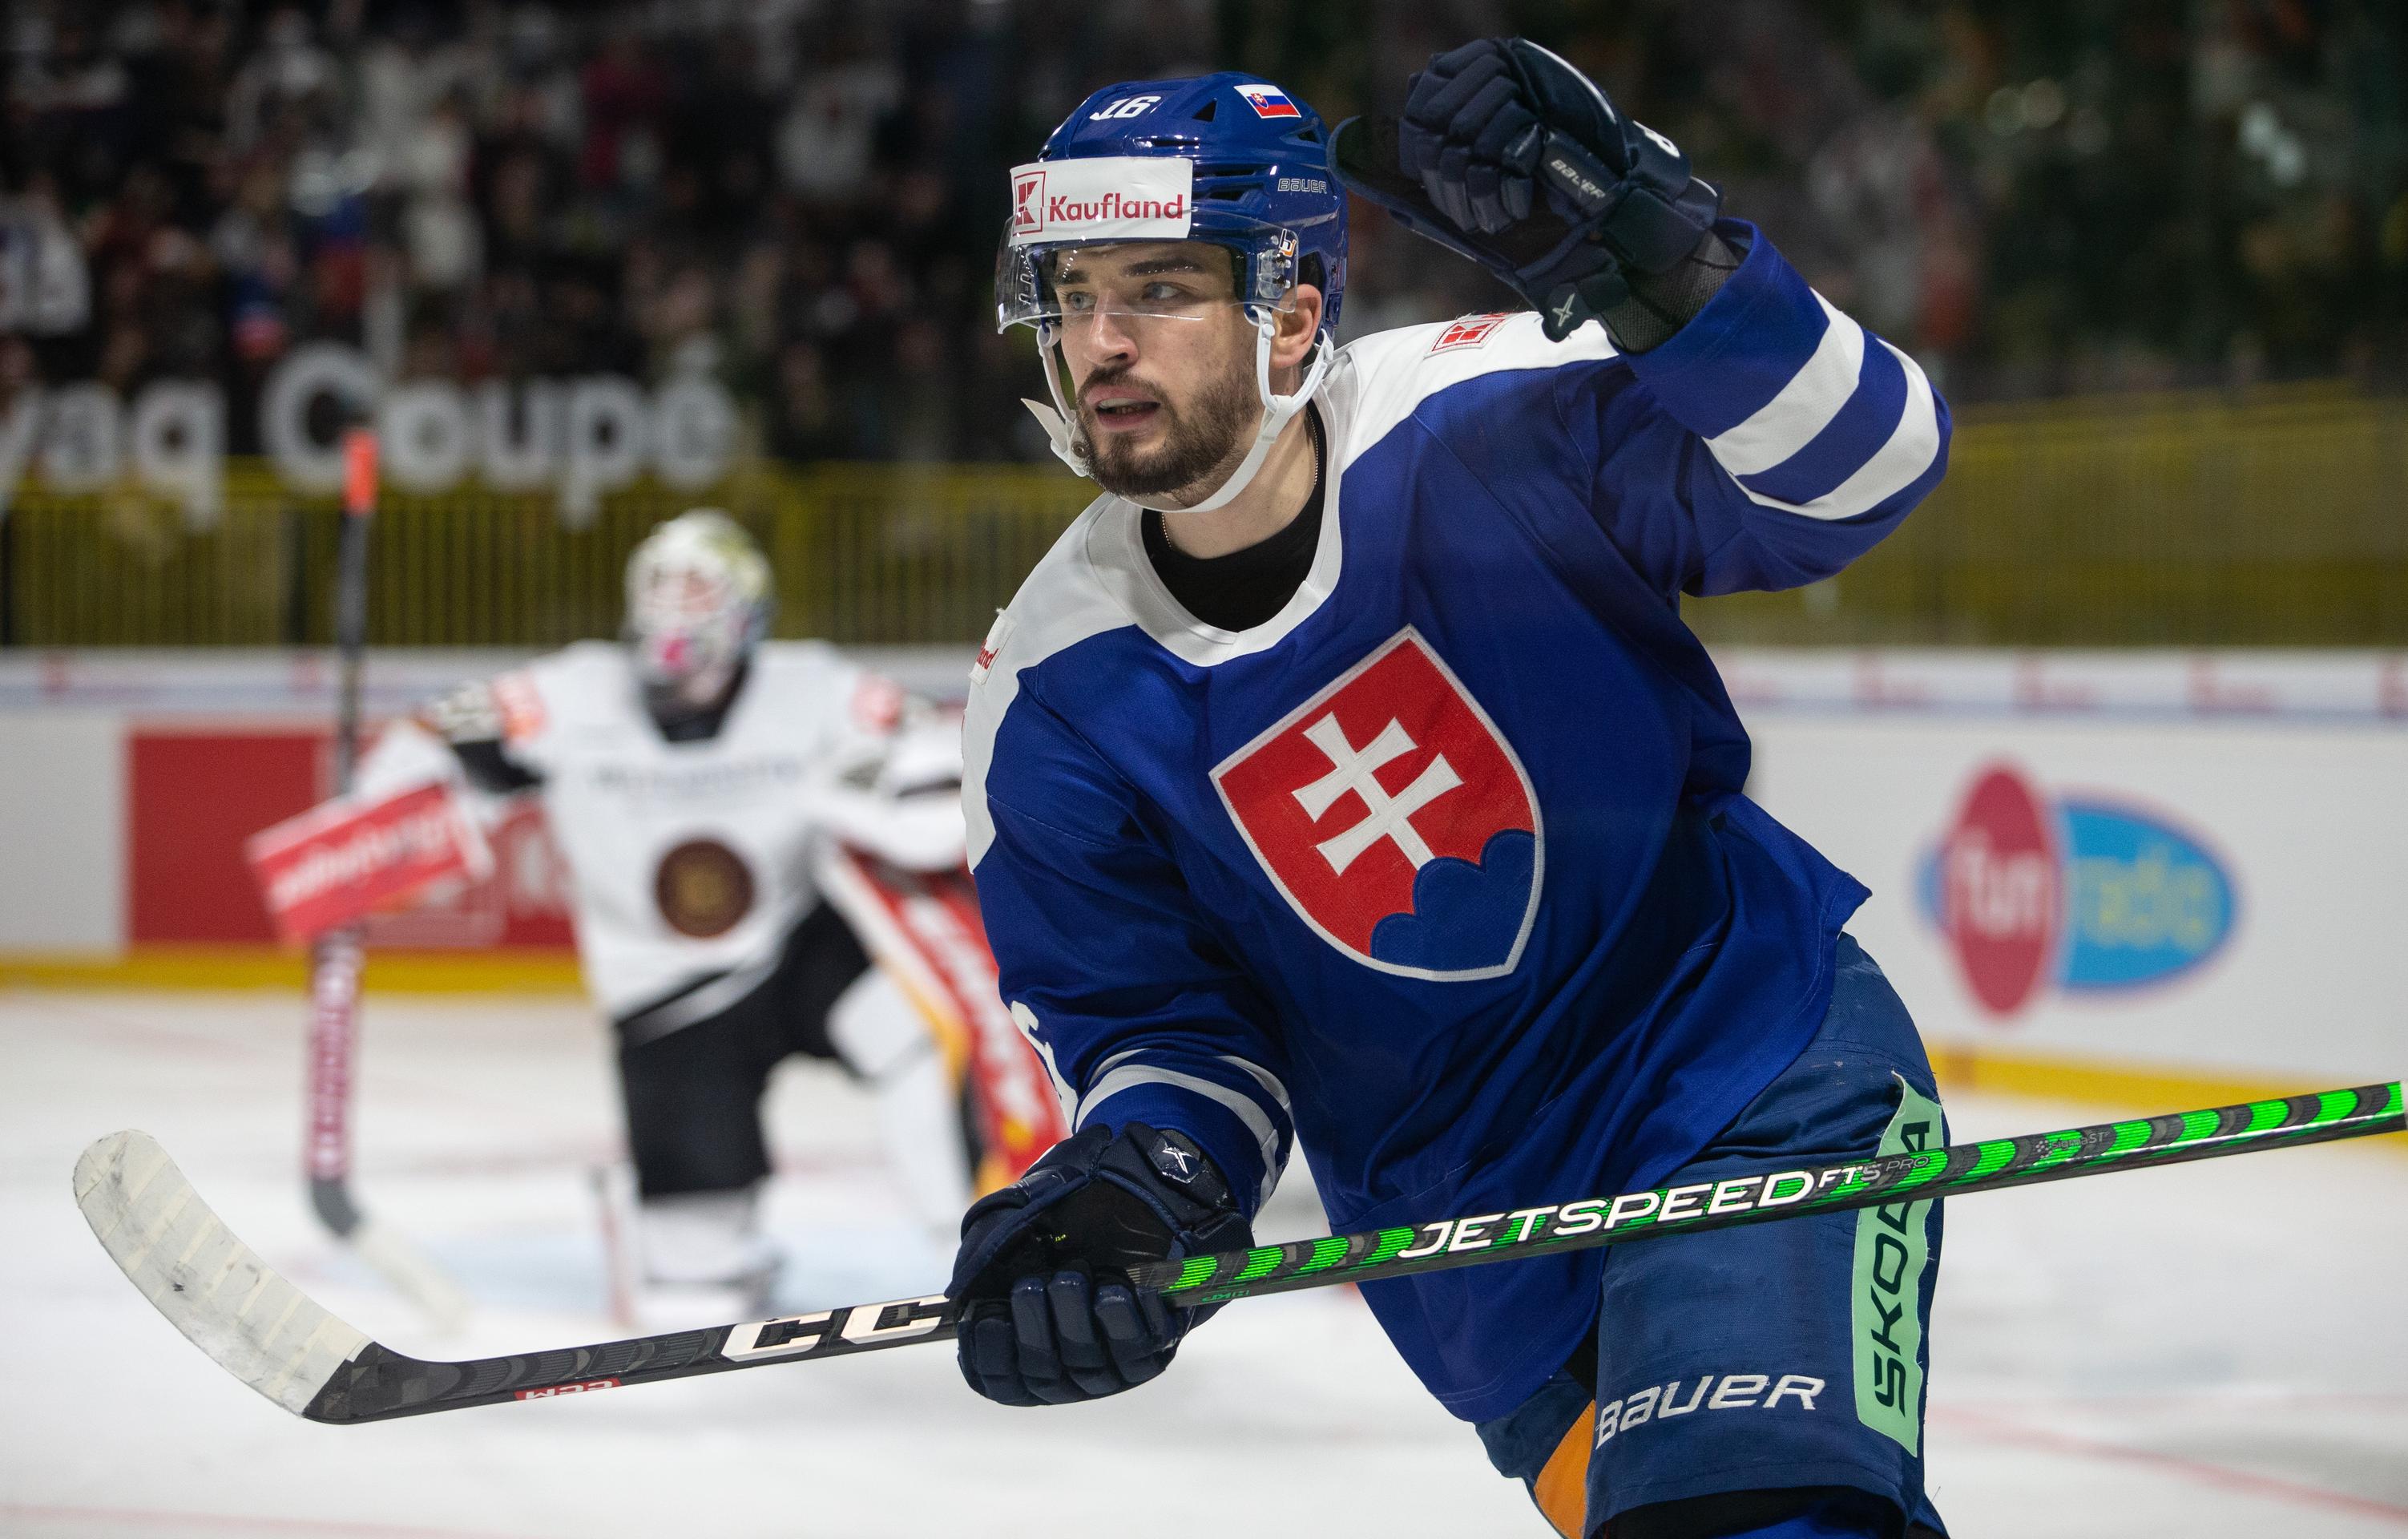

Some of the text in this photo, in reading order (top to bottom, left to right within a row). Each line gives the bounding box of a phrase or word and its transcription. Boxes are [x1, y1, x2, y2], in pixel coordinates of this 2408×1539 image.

[1089, 95, 1162, 121] 16
[1277, 178, 1328, 195] BAUER
[1551, 160, 1606, 198] BAUER
[1049, 192, 1184, 222] Kaufland
[1398, 1170, 1814, 1259] JETSPEED
[1886, 1156, 1930, 1172] PRO
[721, 1293, 951, 1363] CC
[1595, 1374, 1826, 1450] BAUER
